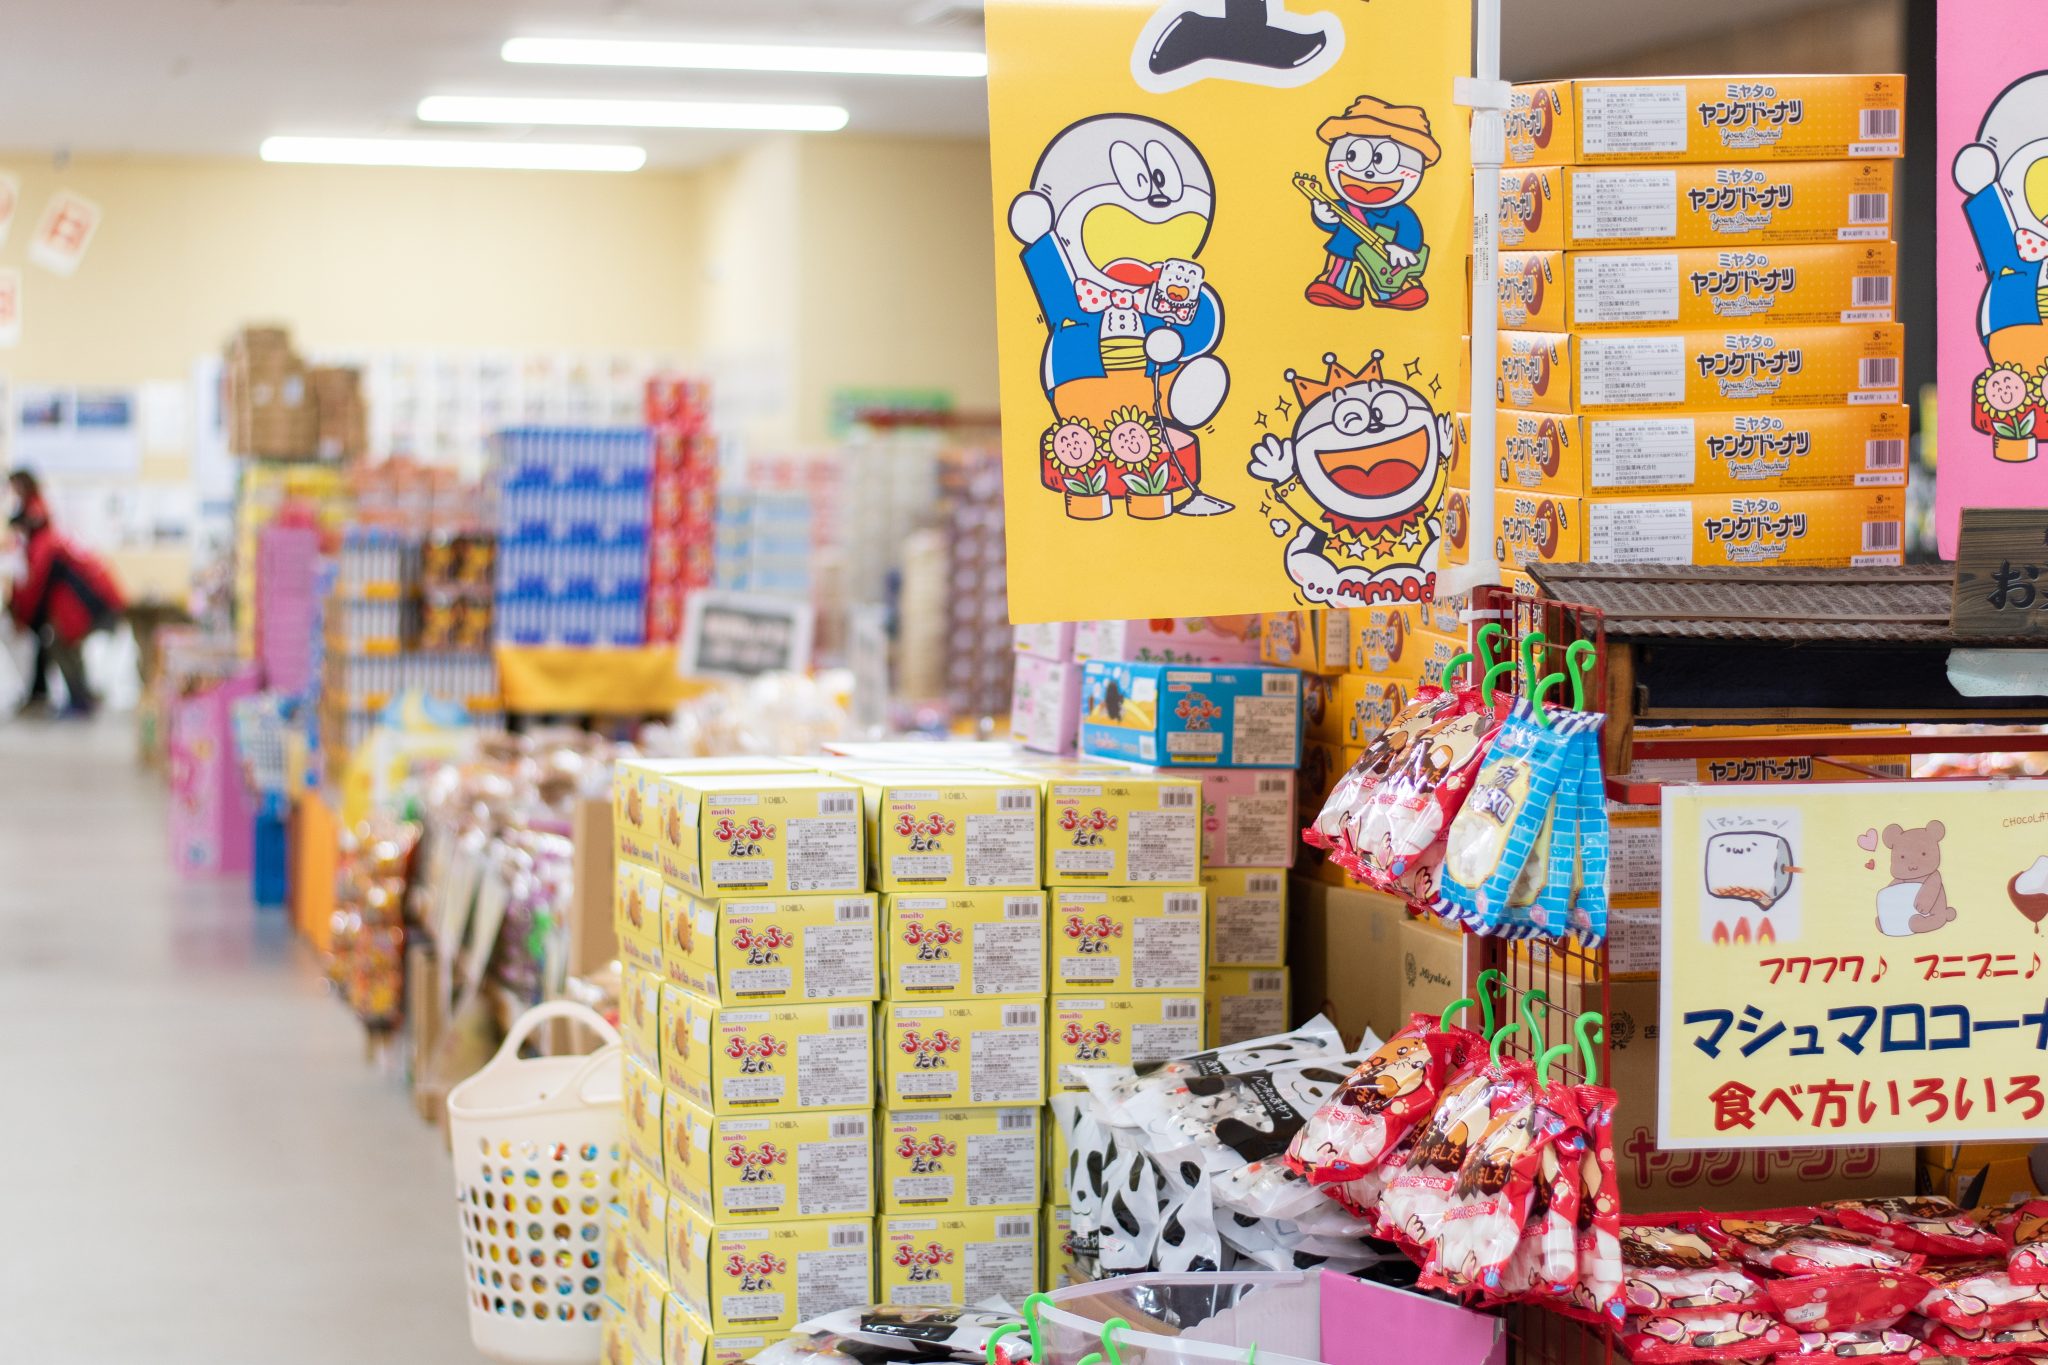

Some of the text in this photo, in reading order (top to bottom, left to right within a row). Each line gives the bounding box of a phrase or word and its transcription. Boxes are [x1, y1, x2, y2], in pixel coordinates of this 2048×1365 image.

[1727, 84, 1776, 99] ミヤタの
[1698, 100, 1803, 127] ヤングドーナツ
[1717, 169, 1765, 184] ミヤタの
[1688, 185, 1792, 212] ヤングドーナツ
[1720, 253, 1768, 268] ミヤタの
[1691, 269, 1795, 296] ヤングドーナツ
[1725, 334, 1775, 349] ミヤタの
[1696, 350, 1802, 377] ヤングドーナツ
[1735, 417, 1783, 432] ミヤタの
[1706, 433, 1810, 460] ヤングドーナツ
[1732, 499, 1780, 514] ミヤタの
[1703, 515, 1807, 542] ヤングドーナツ
[1708, 755, 1814, 782] ヤングドーナツ
[713, 817, 778, 842] ぷくぷく
[894, 812, 957, 837] ぷくぷく
[1057, 807, 1120, 832] ぷくぷく
[729, 840, 762, 858] たい
[909, 835, 941, 852] たい
[1072, 830, 1104, 847] たい
[731, 926, 796, 951] ぷくぷく
[902, 921, 965, 946] ぷくぷく
[1063, 915, 1125, 939] ぷくぷく
[917, 944, 949, 961] たい
[1078, 937, 1110, 954] たい
[747, 949, 780, 967] たい
[1759, 955, 1865, 985] フワフワ
[899, 1029, 962, 1054] ぷくぷく
[1060, 1021, 1123, 1046] ぷくぷく
[724, 1034, 789, 1059] ぷくぷく
[1075, 1044, 1107, 1061] たい
[740, 1057, 773, 1075] たい
[914, 1052, 946, 1069] たい
[1707, 1074, 2046, 1132] 食べ方いろいろ
[724, 1142, 789, 1167] ぷくぷく
[895, 1134, 958, 1159] ぷくぷく
[740, 1165, 773, 1183] たい
[910, 1157, 942, 1174] たい
[724, 1252, 788, 1277] ぷくぷく
[892, 1242, 956, 1266] ぷくぷく
[740, 1275, 772, 1292] たい
[908, 1264, 940, 1282] たい
